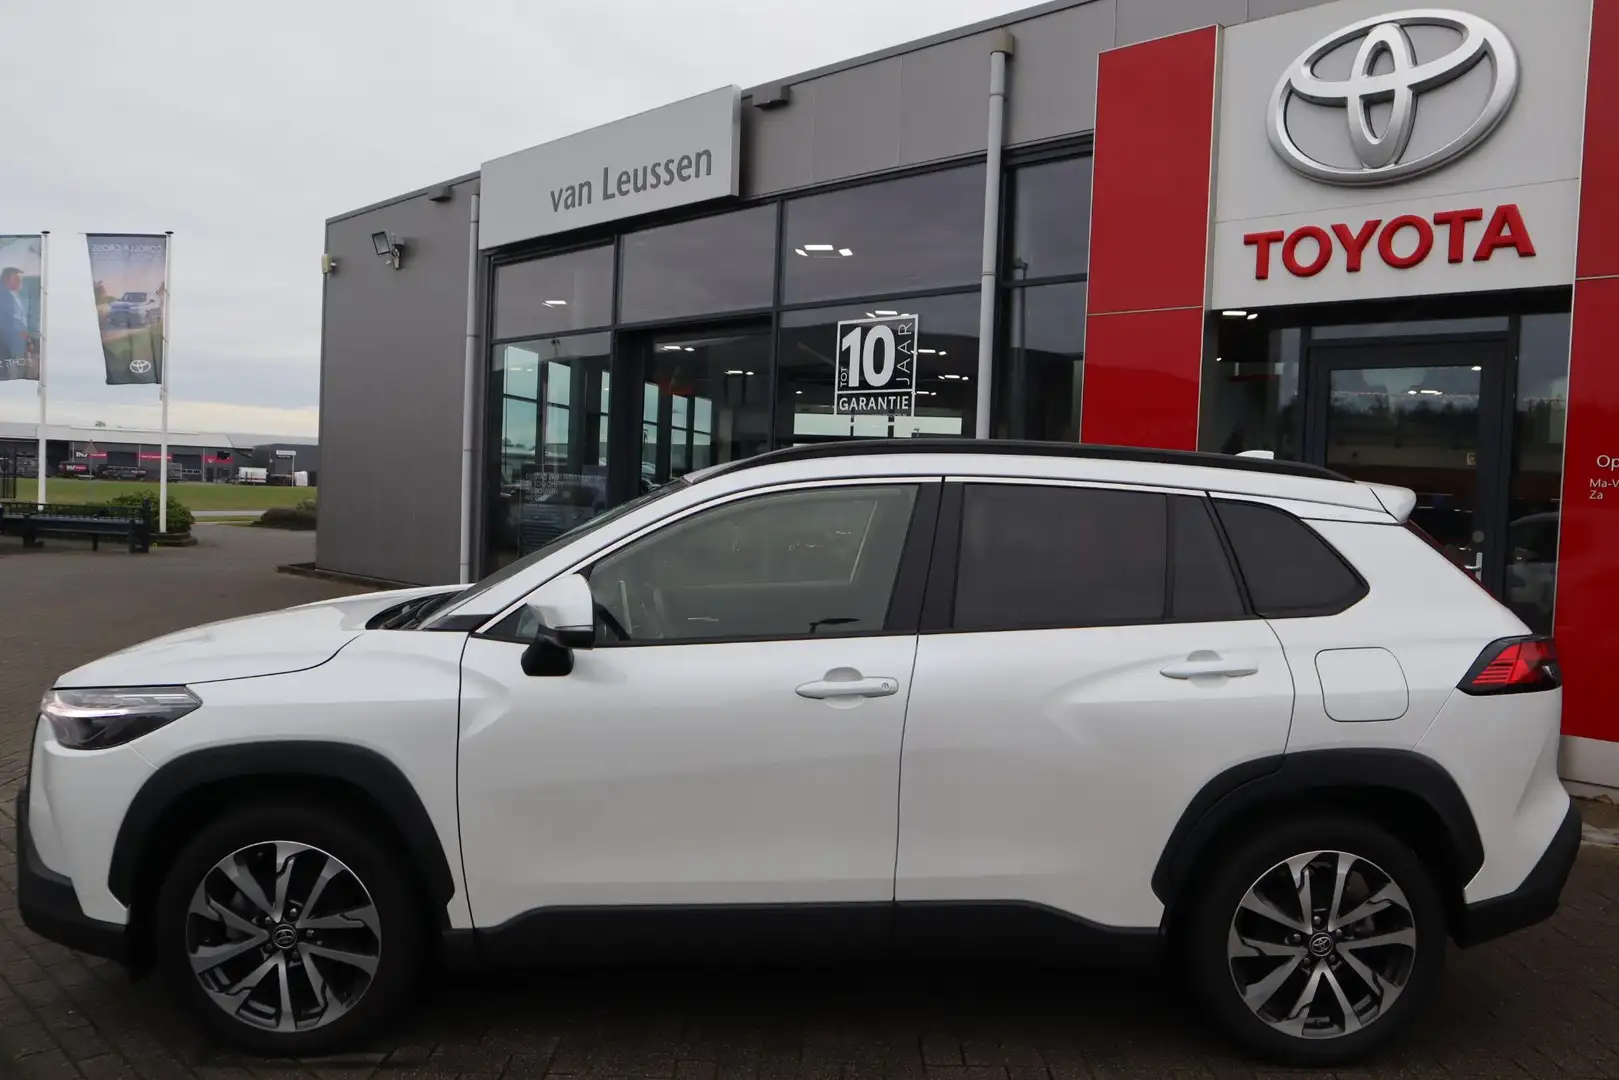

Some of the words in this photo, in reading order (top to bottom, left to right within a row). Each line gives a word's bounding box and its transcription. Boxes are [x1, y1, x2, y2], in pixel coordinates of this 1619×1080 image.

[550, 180, 592, 213] van
[602, 149, 712, 201] Leussen
[1243, 204, 1537, 281] TOYOTA
[841, 324, 896, 388] 10
[896, 322, 913, 386] JAAR
[840, 367, 848, 387] TOT
[840, 396, 909, 411] GARANTIE
[1596, 454, 1619, 471] Op
[1589, 490, 1604, 500] Za
